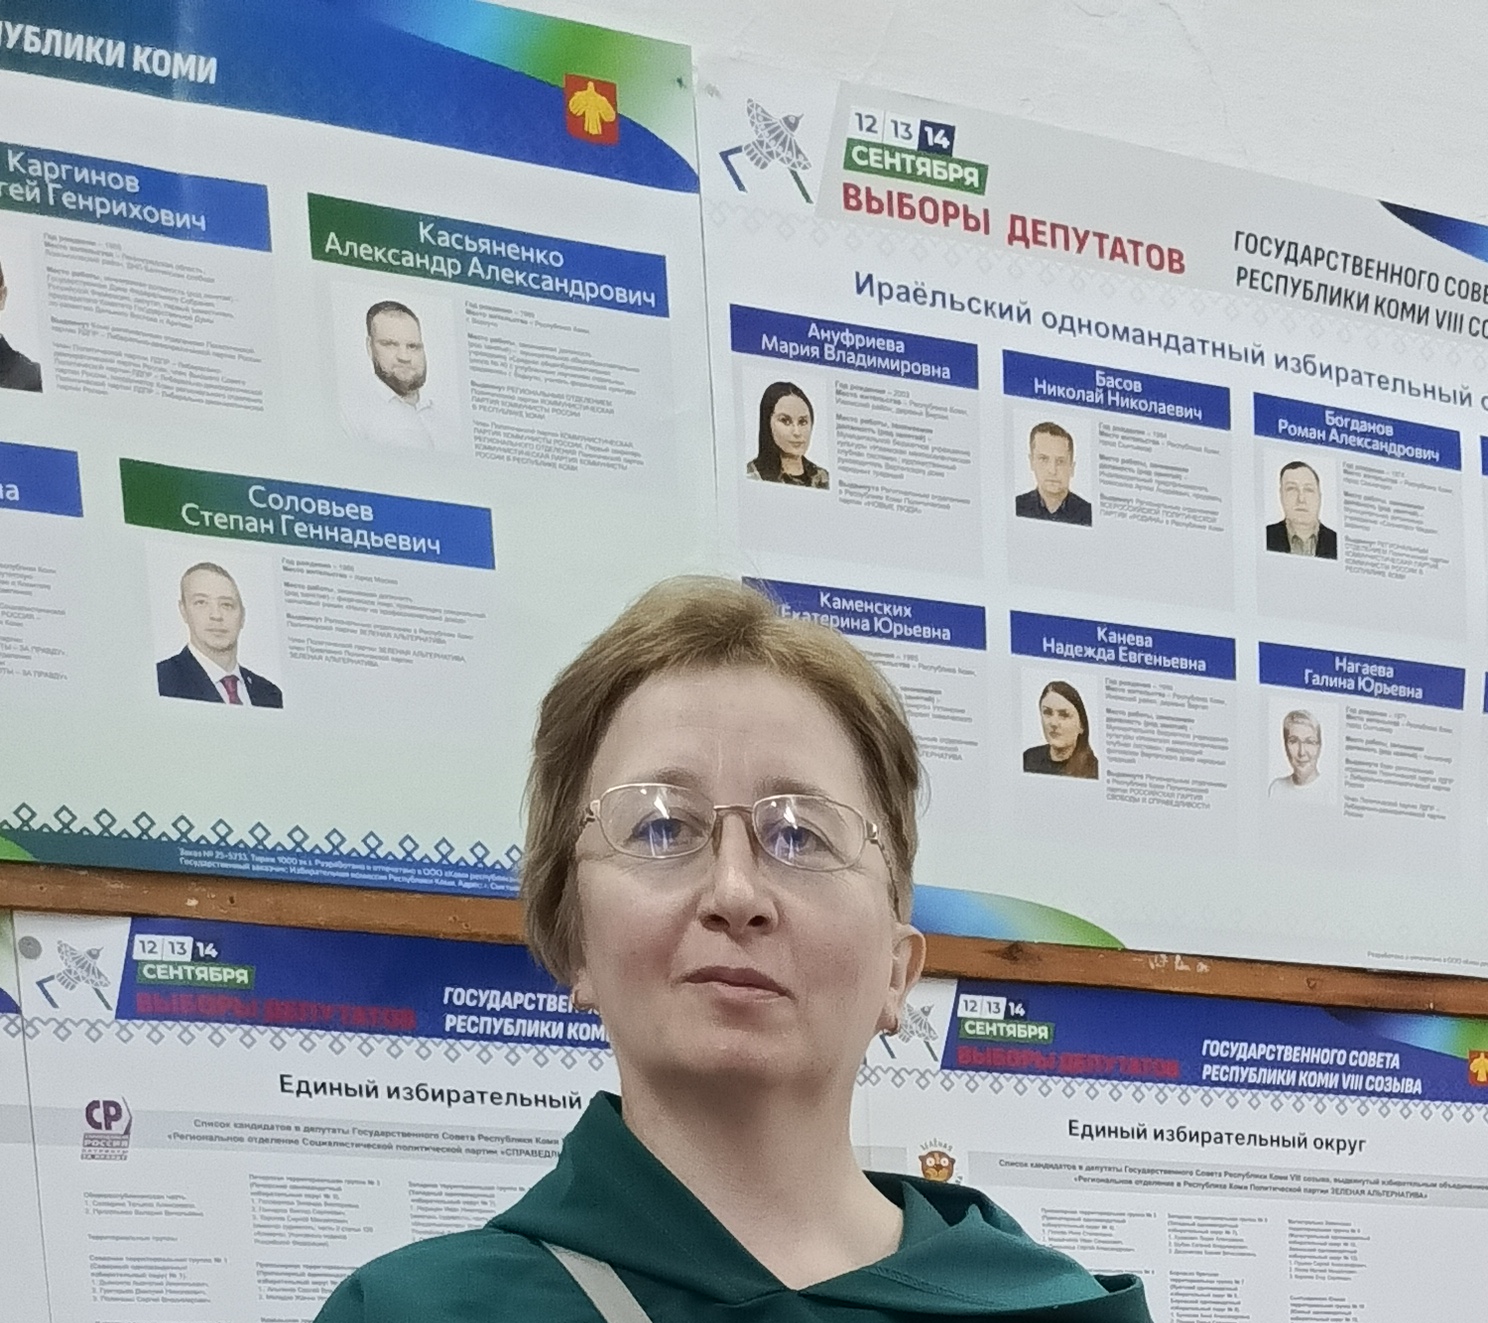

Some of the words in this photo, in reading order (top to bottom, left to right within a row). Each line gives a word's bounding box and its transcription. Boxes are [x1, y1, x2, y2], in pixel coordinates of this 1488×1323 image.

[132, 43, 218, 84] КОМИ
[854, 112, 878, 133] 12
[890, 119, 913, 141] 13
[924, 125, 950, 149] 14
[7, 149, 140, 193] Каргинов
[851, 145, 980, 188] СЕНТЯБРЯ
[47, 183, 206, 231] Генрихович
[418, 220, 564, 268] Касьяненко
[843, 182, 990, 236] ВЫБОРЫ
[1007, 213, 1186, 275] ДЕПУТАТОВ
[325, 231, 461, 279] Александр
[467, 255, 656, 308] Александрович
[1234, 230, 1439, 293] ГОСУДАРСТВЕННОГО
[1236, 266, 1369, 314] РЕСПУБЛИКИ
[1374, 295, 1430, 326] КОМИ
[1435, 309, 1464, 334] VIII
[761, 333, 820, 359] Мария
[824, 344, 951, 379] Владимировна
[808, 322, 905, 354] Ануфриева
[854, 270, 1032, 325] Ираёльский
[1041, 310, 1266, 367] одномандатный
[1274, 351, 1473, 408] избирательный
[1034, 377, 1104, 404] Николай
[1107, 392, 1203, 421] Николаевич
[1095, 369, 1143, 393] Басов
[1278, 419, 1326, 441] Роман
[1328, 427, 1440, 463] Александрович
[1325, 409, 1394, 437] Богданов
[248, 484, 374, 521] Соловьев
[181, 503, 275, 535] Степан
[281, 514, 441, 555] Геннадьевич
[819, 591, 913, 618] Каменских
[873, 616, 951, 641] Юрьевна
[1096, 626, 1153, 648] Канева
[1043, 637, 1115, 662] Надежда
[1118, 646, 1207, 671] Евгеньевна
[1335, 656, 1394, 679] Нагаева
[1304, 668, 1355, 691] Галина
[1358, 677, 1423, 700] Юрьевна
[139, 940, 158, 955] 12
[168, 941, 187, 956] 13
[196, 941, 218, 958] 14
[142, 963, 249, 985] СЕНТЯБРЯ
[443, 987, 599, 1014] ГОСУДАРСТВЕ
[963, 1000, 978, 1012] 12
[987, 1001, 1001, 1014] 13
[1008, 1001, 1025, 1017] 14
[444, 1014, 563, 1039] РЕСПУБЛИКИ
[567, 1022, 611, 1042] КОМ
[964, 1020, 1049, 1040] СЕНТЯБРЯ
[1202, 1039, 1346, 1065] ГОСУДАРСТВЕННОГО
[1348, 1050, 1400, 1070] СОВЕТА
[279, 1073, 379, 1100] Единый
[387, 1083, 583, 1110] избирательный
[1202, 1064, 1297, 1087] РЕСПУБЛИКИ
[1298, 1070, 1339, 1089] КОМИ
[1341, 1073, 1364, 1091] VIII
[1365, 1075, 1423, 1095] СОЗЫВА
[1068, 1119, 1148, 1141] Единый
[1152, 1125, 1308, 1150] избирательный
[1313, 1135, 1366, 1156] округ
